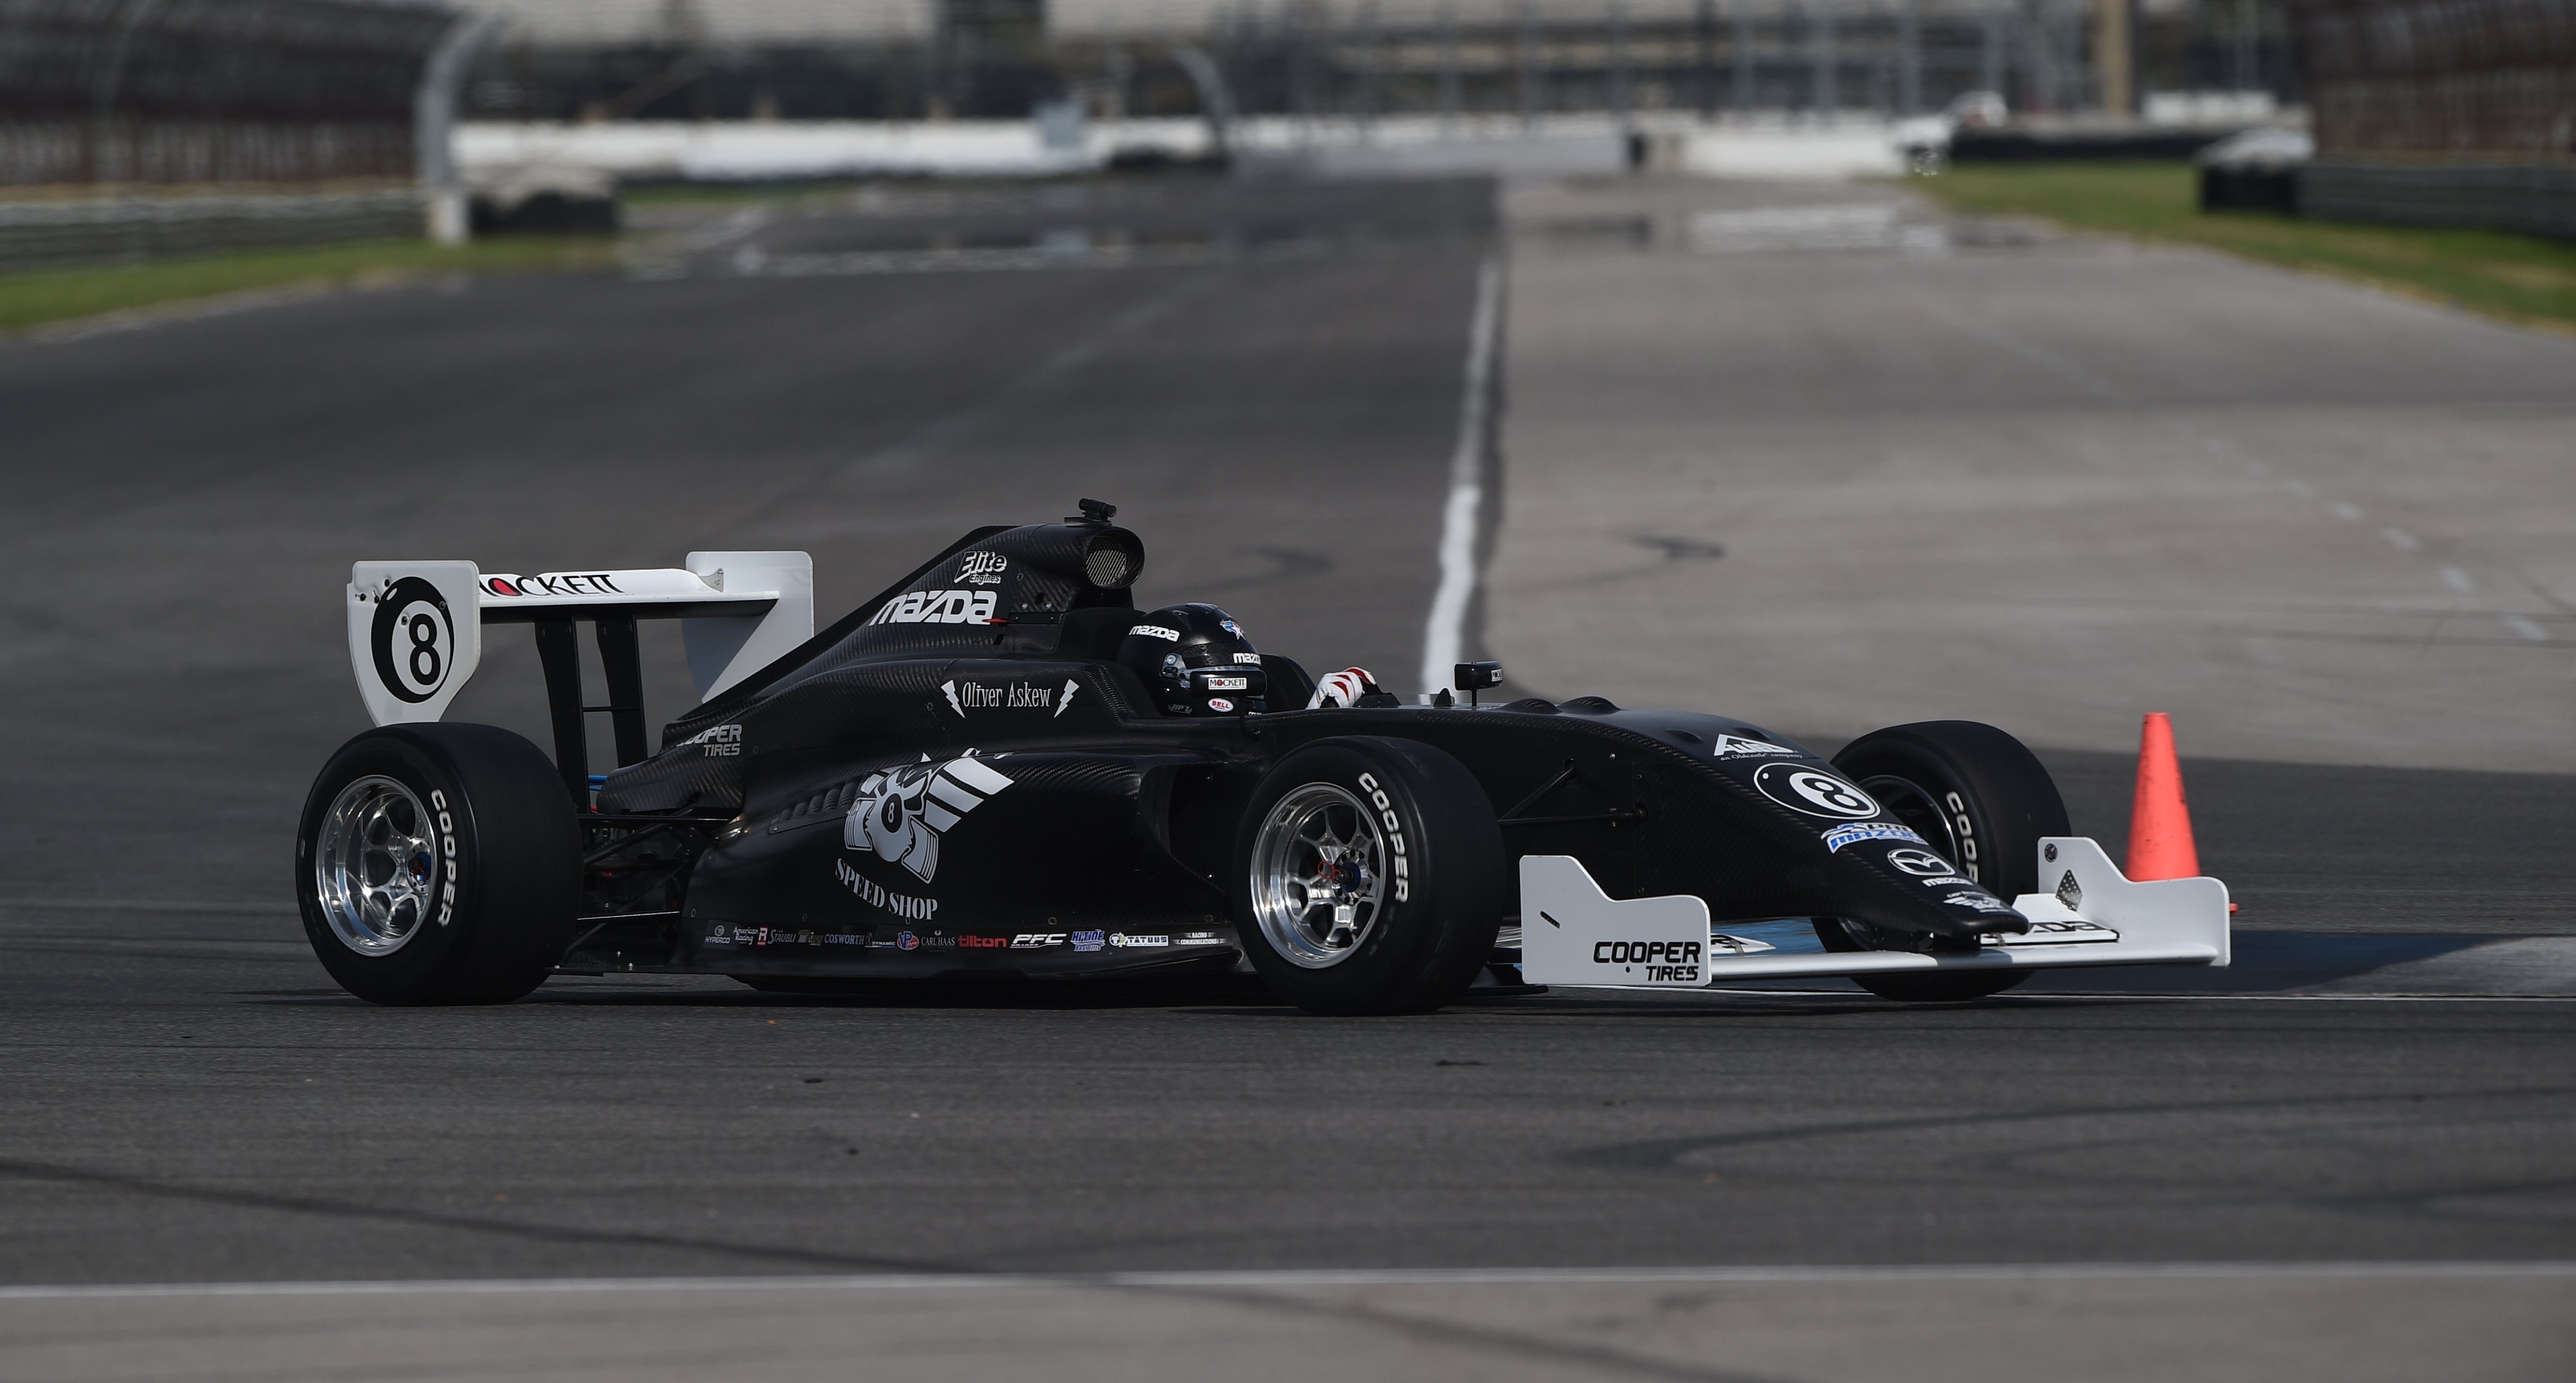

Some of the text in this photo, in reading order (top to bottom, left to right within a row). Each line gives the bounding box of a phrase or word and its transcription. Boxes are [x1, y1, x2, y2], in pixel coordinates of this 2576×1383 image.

[954, 551, 1007, 583] Elite
[969, 573, 1001, 585] Engines
[409, 613, 441, 686] 8
[962, 681, 1052, 708] Oliver Askew
[1212, 700, 1230, 709] BELL
[703, 743, 741, 757] TIRES
[1801, 776, 1871, 810] 8
[887, 802, 894, 823] 8
[1358, 771, 1409, 904] COOPER
[431, 789, 457, 928] COOPER
[835, 858, 938, 921] SPEED SHOP
[705, 936, 730, 944] HYPERCO
[735, 932, 754, 946] Racing
[824, 933, 864, 945] COSWORTH
[898, 931, 913, 949] VP
[921, 937, 937, 946] CARL
[938, 937, 955, 946] HAAS
[957, 935, 1007, 947] tilton
[1012, 933, 1067, 944] PFC
[1593, 941, 1701, 963] COOPER
[1645, 966, 1699, 981] TIRES
